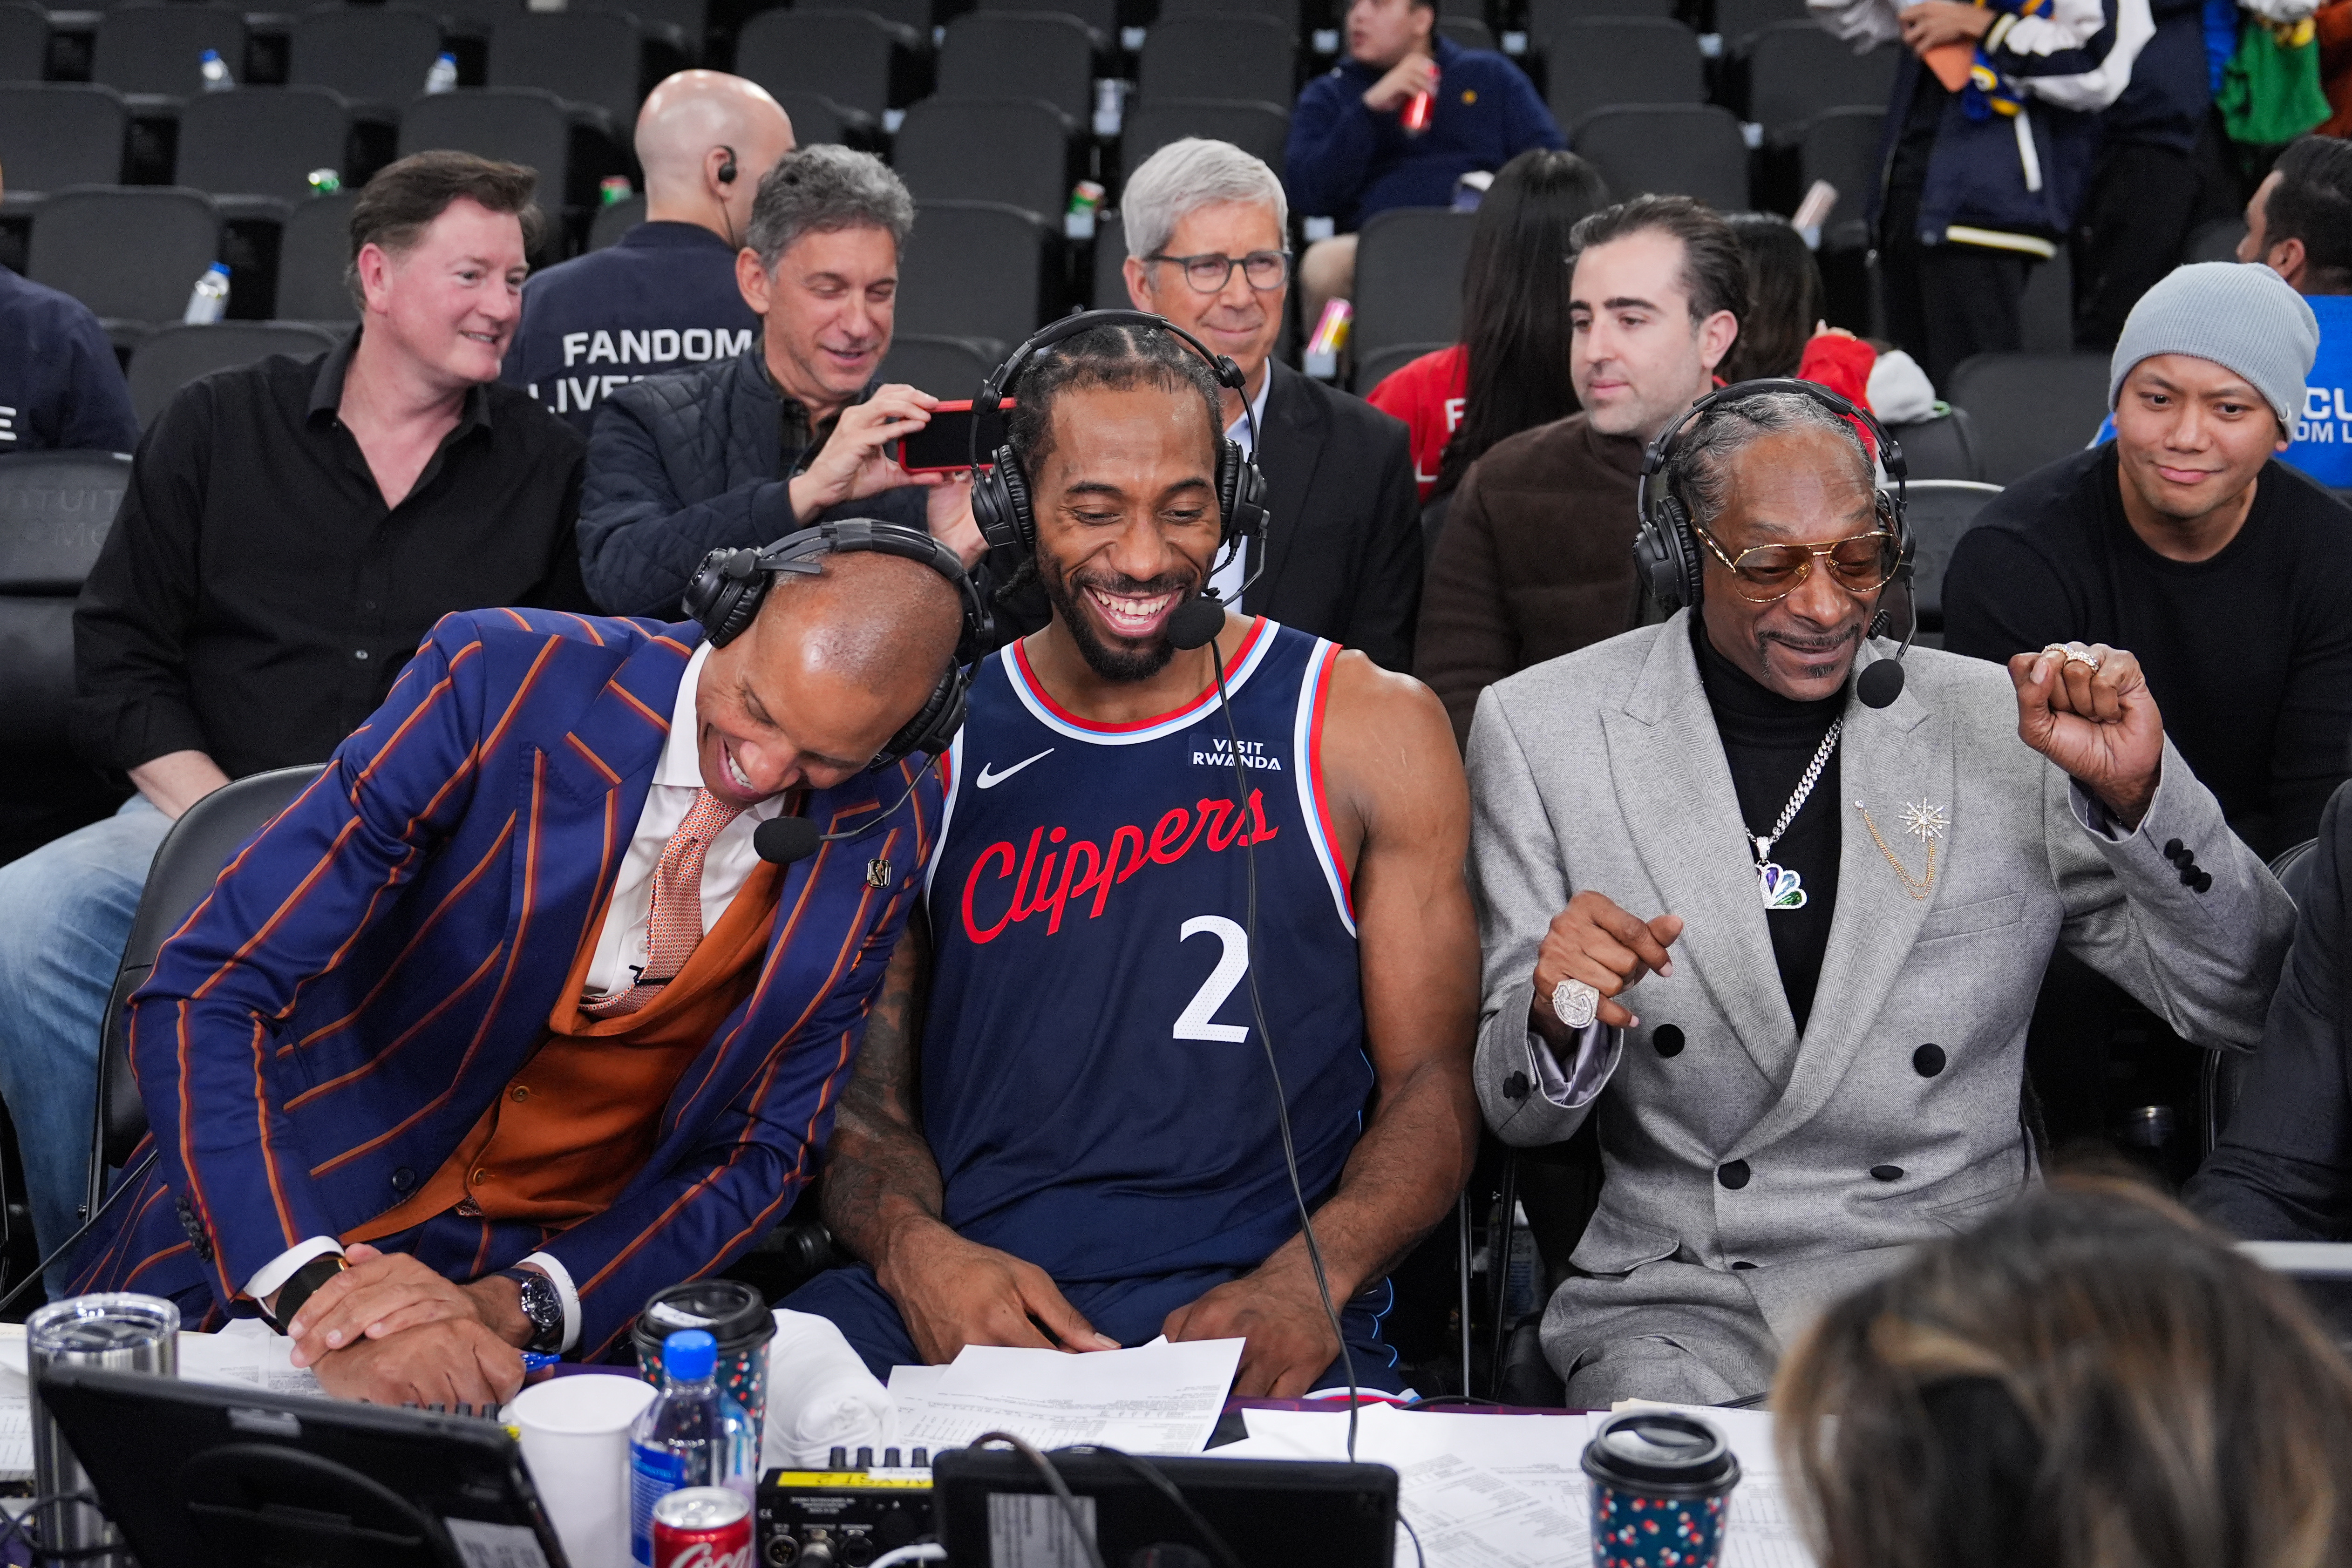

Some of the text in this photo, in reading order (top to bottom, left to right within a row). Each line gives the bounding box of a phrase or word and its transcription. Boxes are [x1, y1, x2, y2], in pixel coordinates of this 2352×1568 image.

[563, 328, 752, 367] FANDOM
[1193, 752, 1281, 770] RWANDA
[1213, 739, 1264, 755] VISIT
[962, 787, 1279, 944] Clippers
[1173, 915, 1250, 1043] 2
